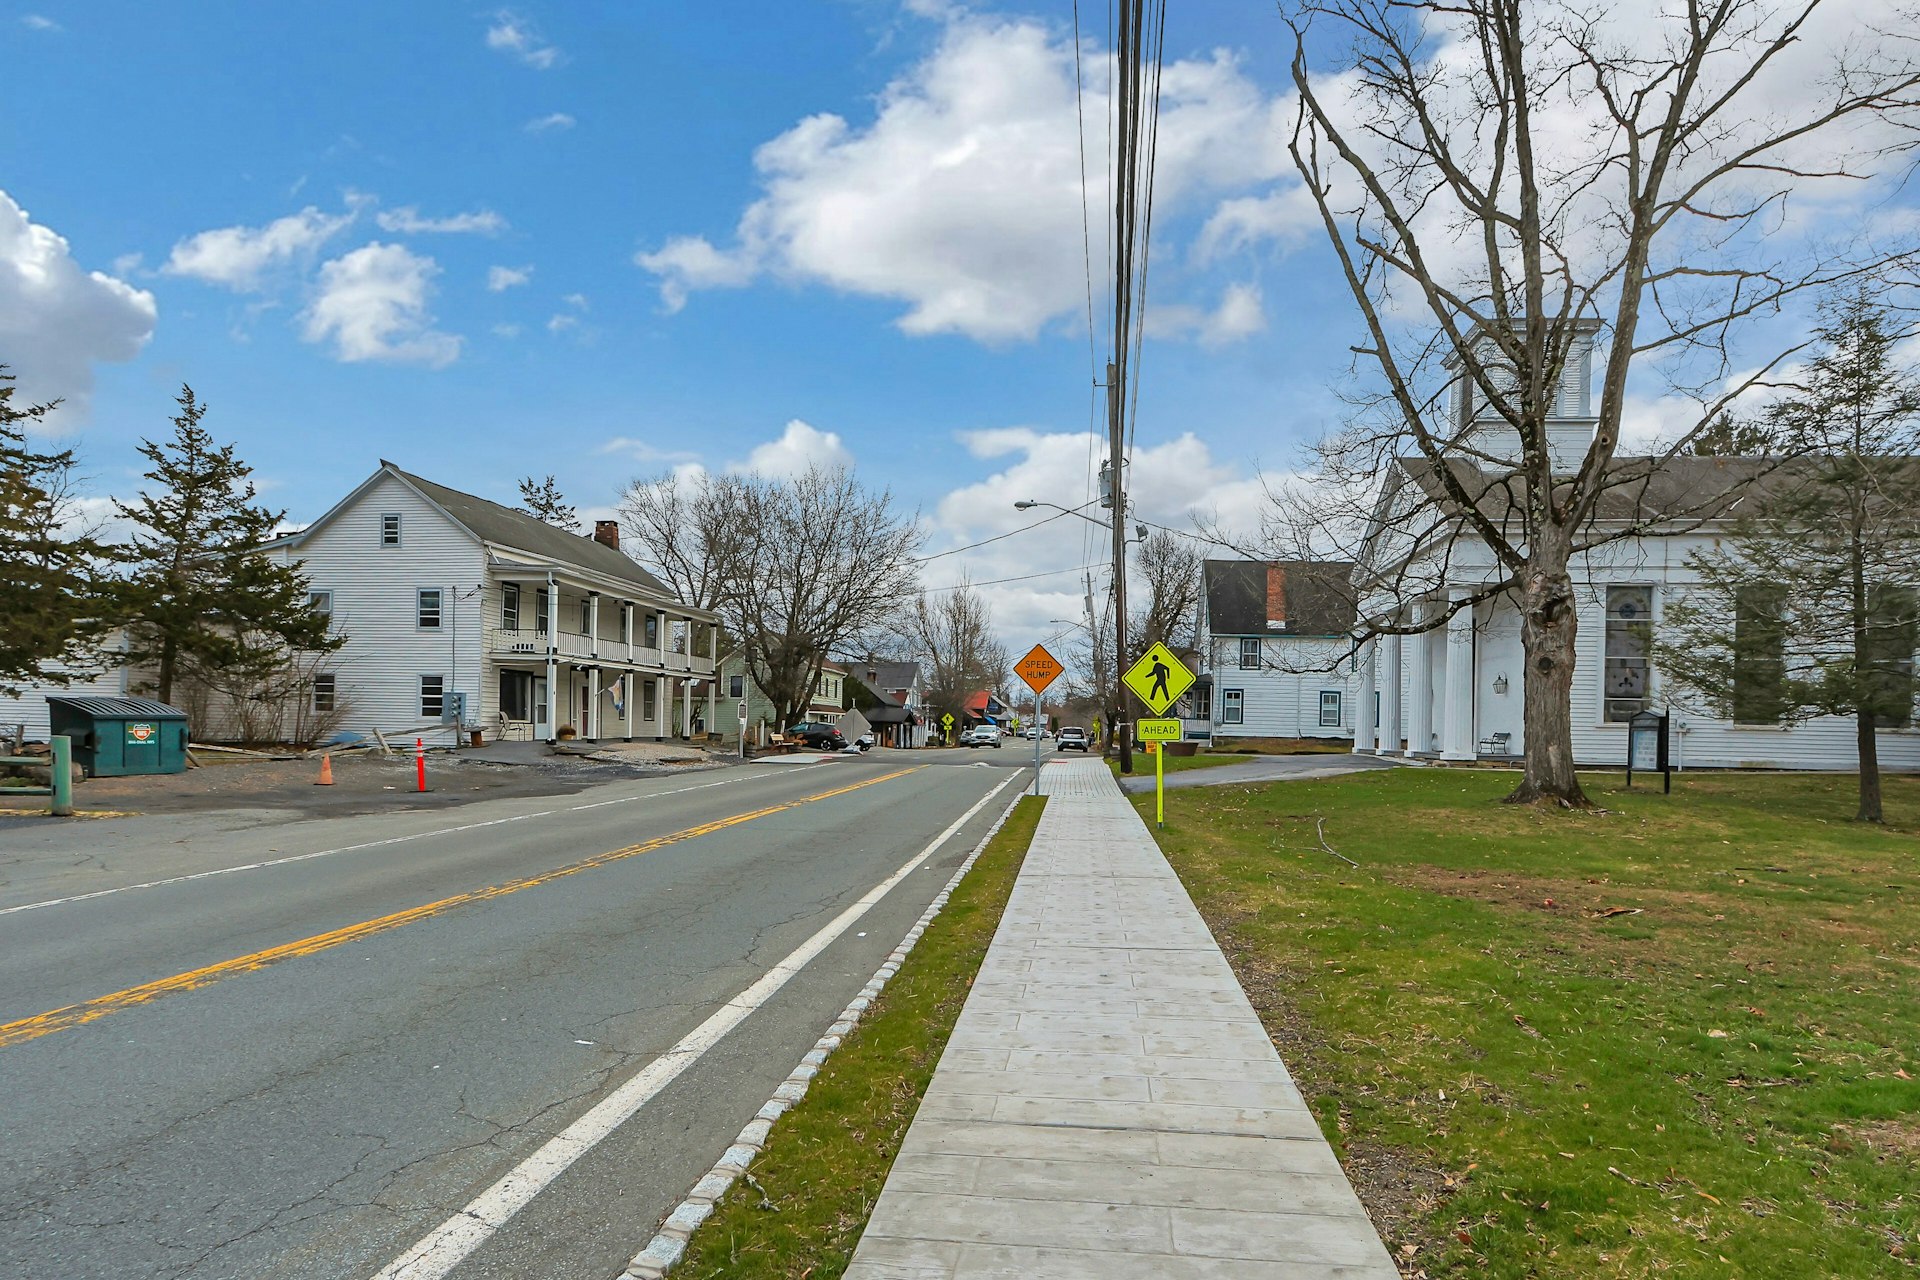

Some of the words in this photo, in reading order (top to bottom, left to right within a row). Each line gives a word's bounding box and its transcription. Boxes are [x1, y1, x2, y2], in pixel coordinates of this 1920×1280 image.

[1025, 660, 1053, 669] SPEED
[1026, 670, 1051, 679] HUMP
[1144, 725, 1175, 735] AHEAD
